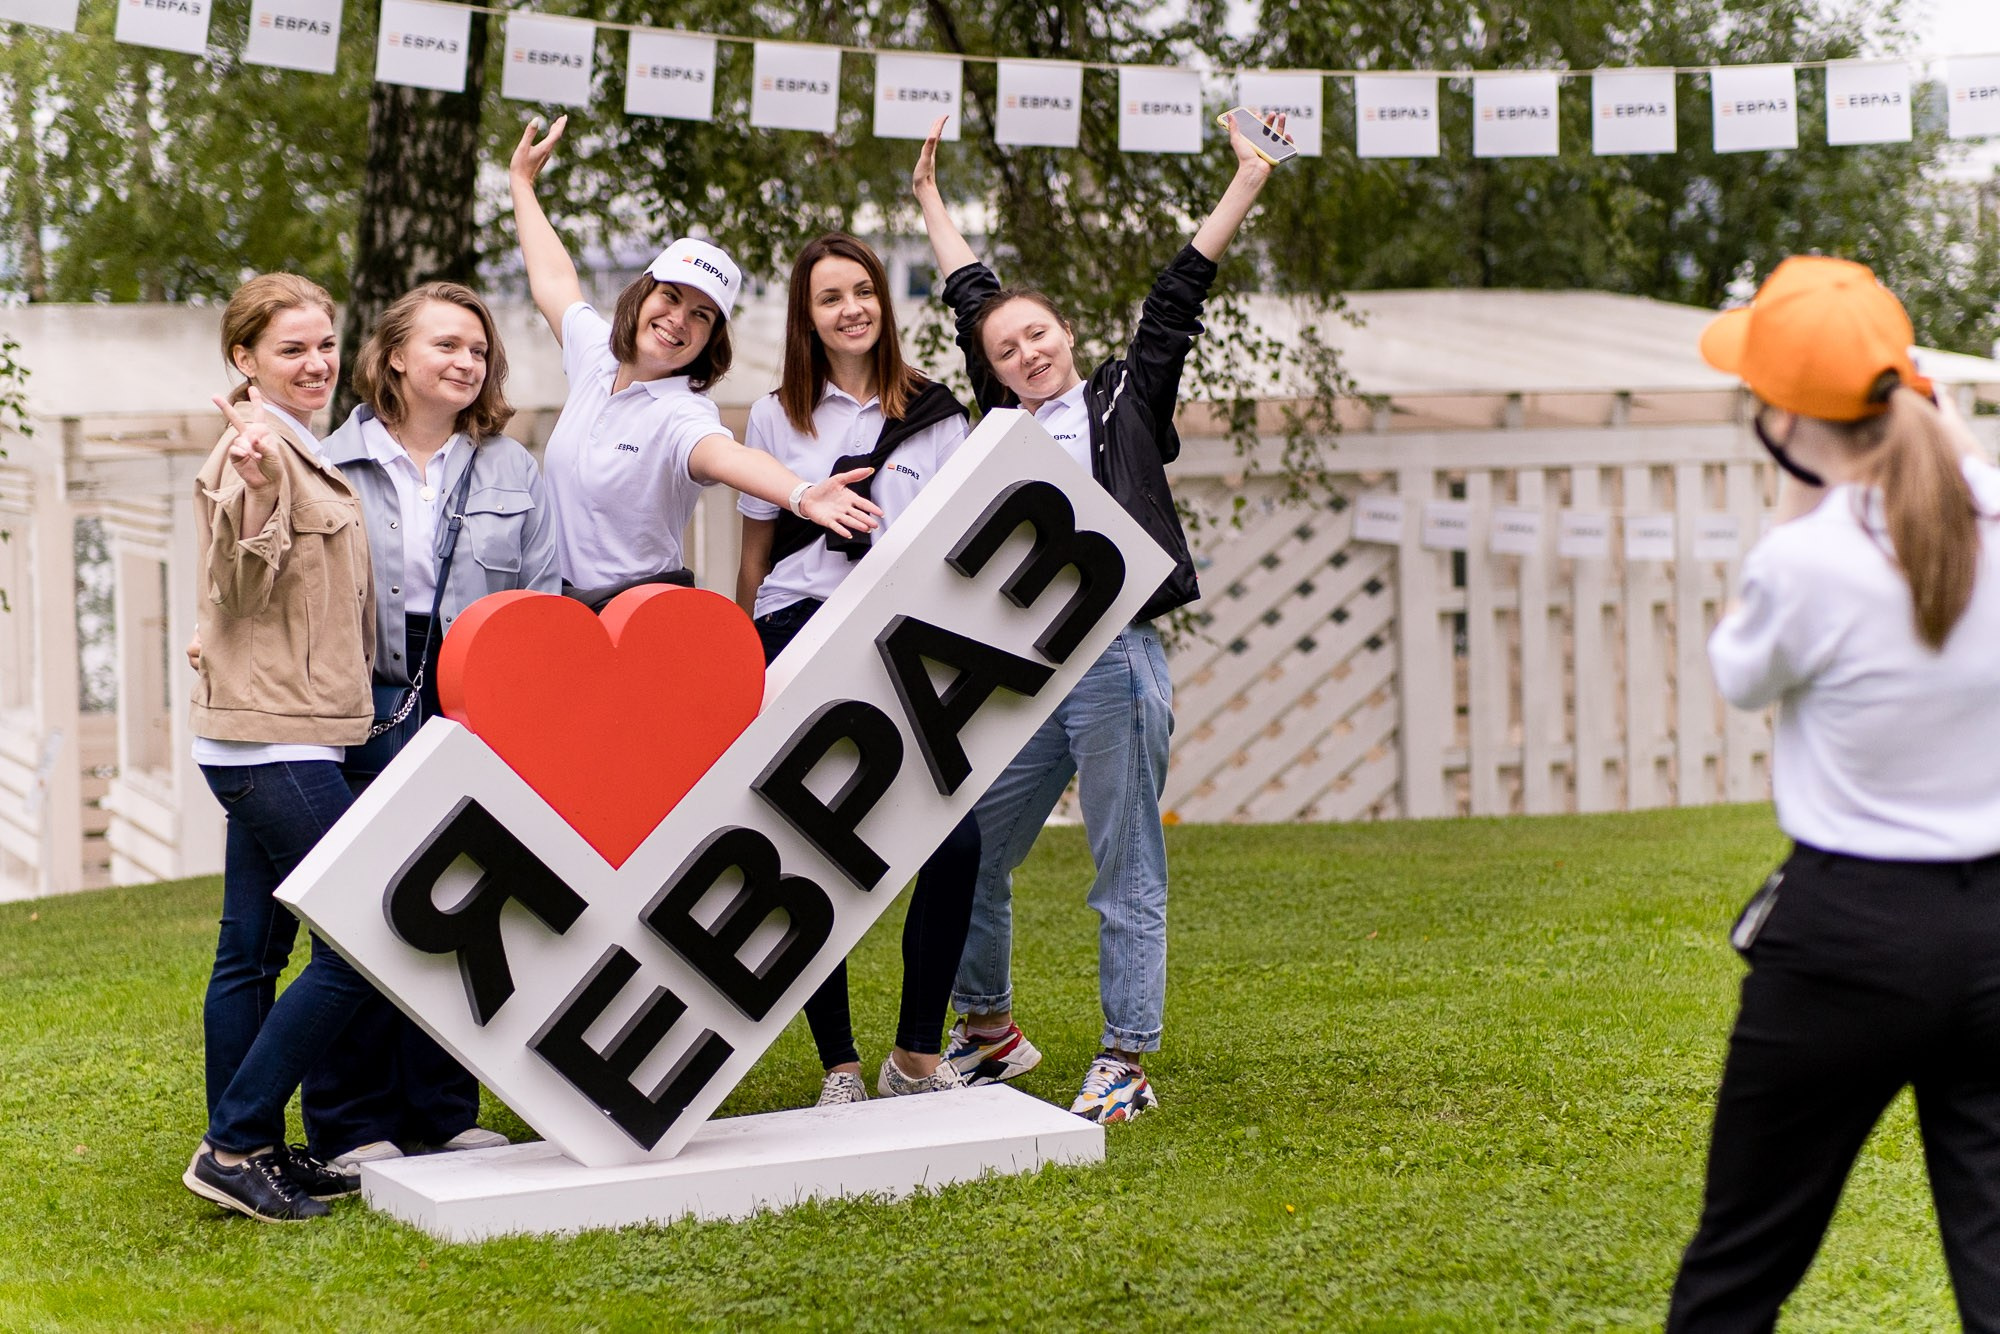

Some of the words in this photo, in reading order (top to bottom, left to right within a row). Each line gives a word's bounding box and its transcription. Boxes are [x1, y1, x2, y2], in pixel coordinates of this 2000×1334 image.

[274, 15, 331, 36] ЕВРАЗ
[402, 34, 459, 53] ЕВРАЗ
[527, 49, 584, 69] ЕВРАЗ
[650, 65, 705, 83] ЕВРАЗ
[775, 78, 830, 94] ЕВРАЗ
[898, 89, 952, 103] ЕВРАЗ
[1019, 96, 1072, 110] ЕВРАЗ
[1849, 92, 1902, 107] ЕВРАЗ
[1141, 102, 1193, 115] ЕВРАЗ
[1378, 108, 1430, 121] ЕВРАЗ
[1496, 107, 1549, 120] ЕВРАЗ
[1615, 104, 1666, 117] ЕВРАЗ
[1735, 98, 1788, 115] ЕВРАЗ
[693, 258, 729, 287] ЕВРАЗ
[1053, 433, 1077, 441] ВРАЗ
[896, 464, 920, 481] ЕВРАЗ
[526, 480, 1126, 1152] ЕВРАЗ
[383, 796, 589, 1027] Я
